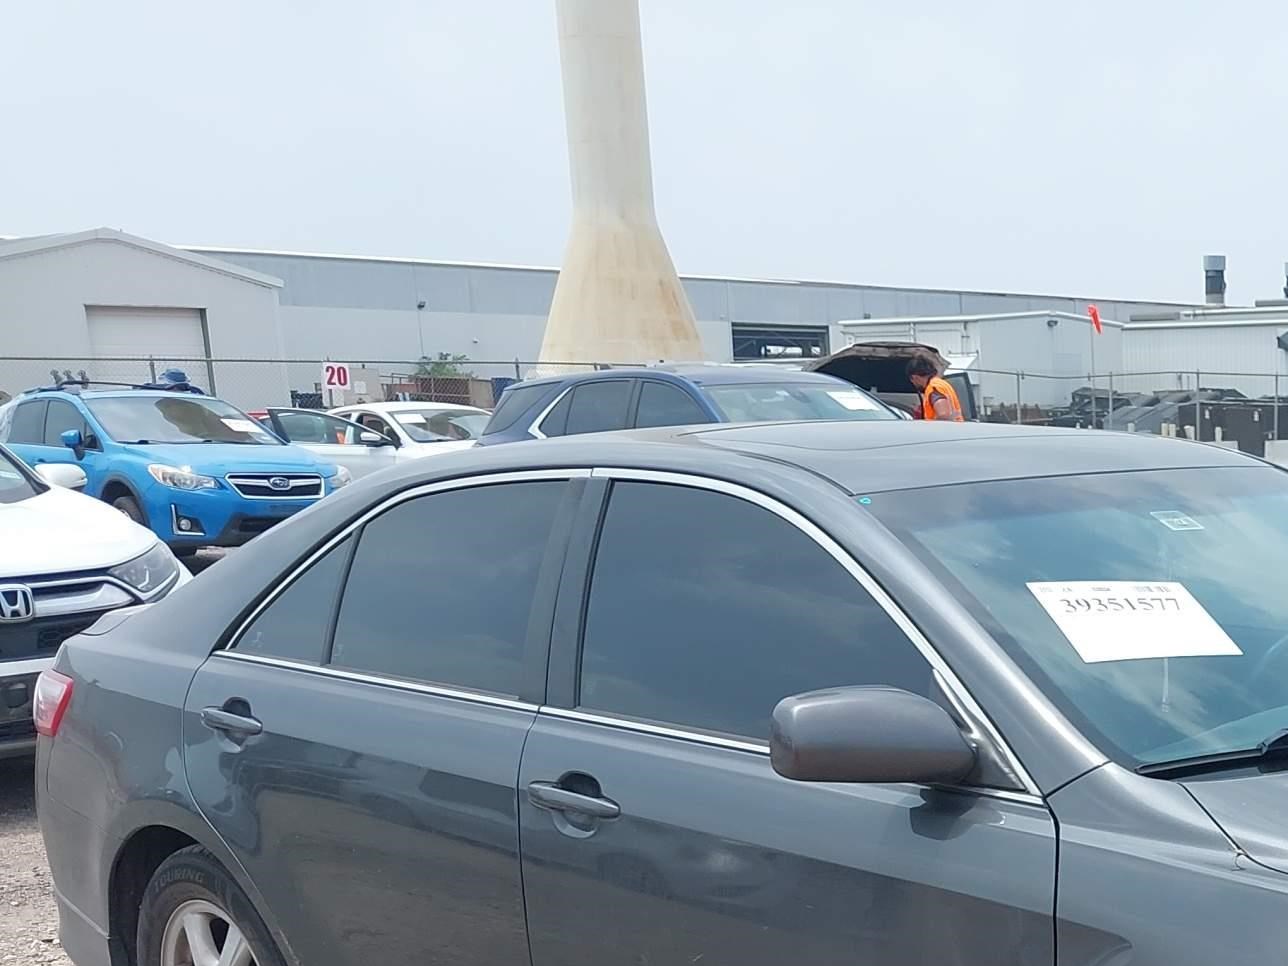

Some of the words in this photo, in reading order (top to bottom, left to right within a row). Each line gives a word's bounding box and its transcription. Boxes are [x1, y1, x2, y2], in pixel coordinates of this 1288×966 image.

[326, 366, 348, 386] 20
[1059, 598, 1181, 614] 39351577
[154, 867, 205, 893] TOURING
